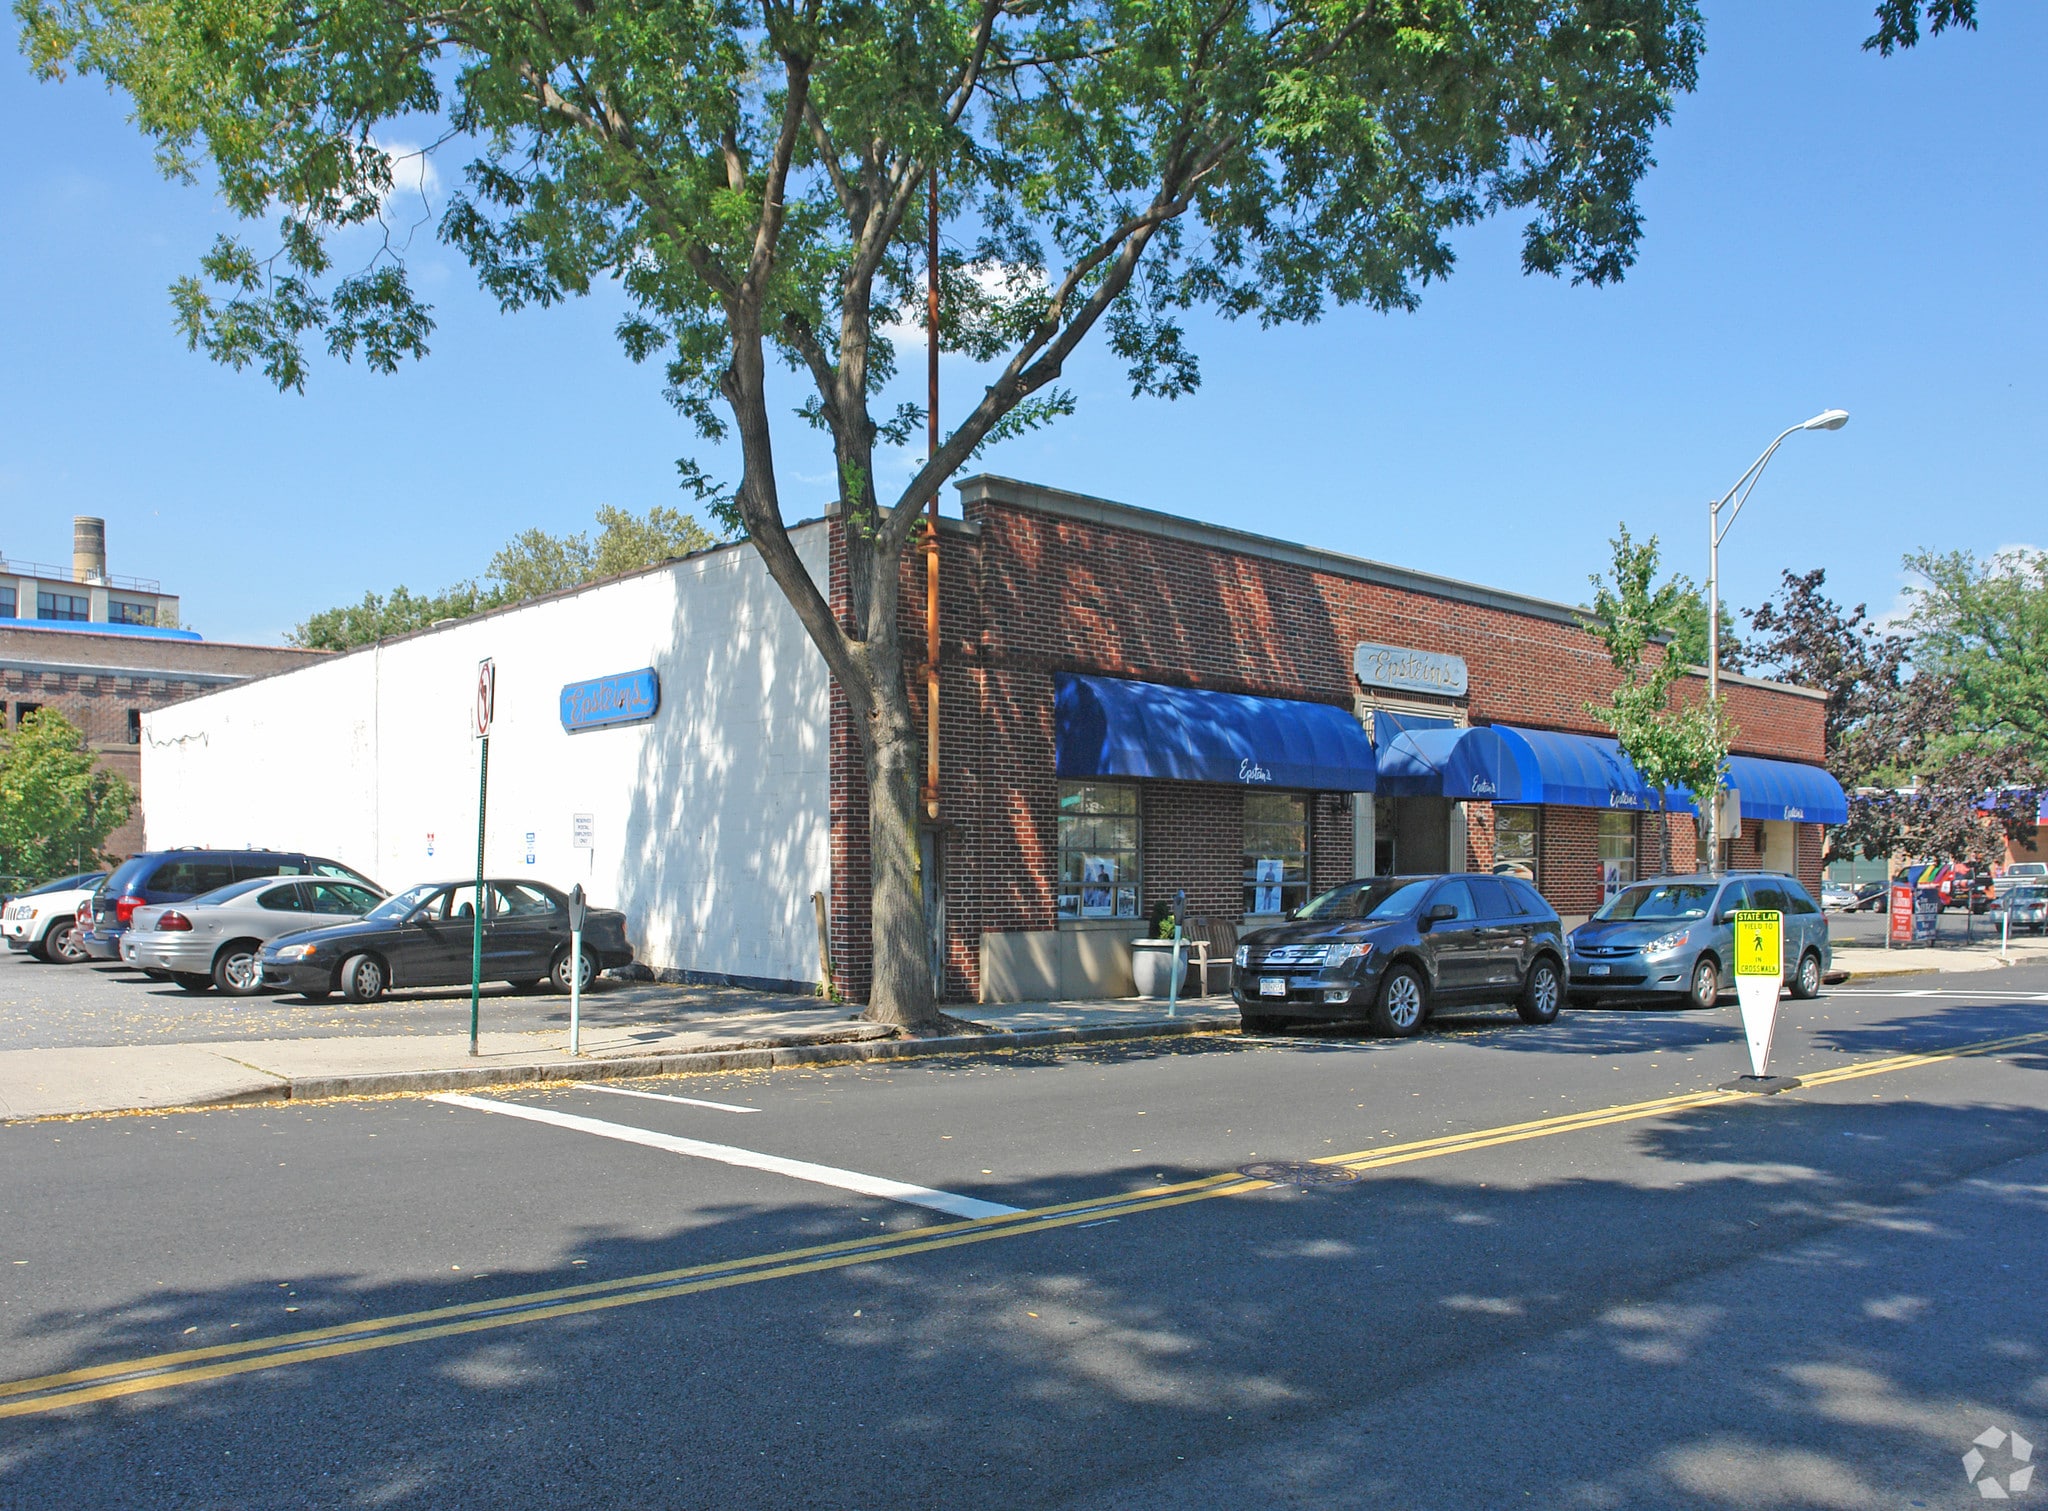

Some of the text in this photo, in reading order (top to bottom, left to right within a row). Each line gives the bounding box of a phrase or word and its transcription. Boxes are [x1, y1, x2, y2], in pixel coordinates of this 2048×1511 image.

[1738, 913, 1778, 921] STATE LAW
[1741, 965, 1777, 973] CROSSWALK
